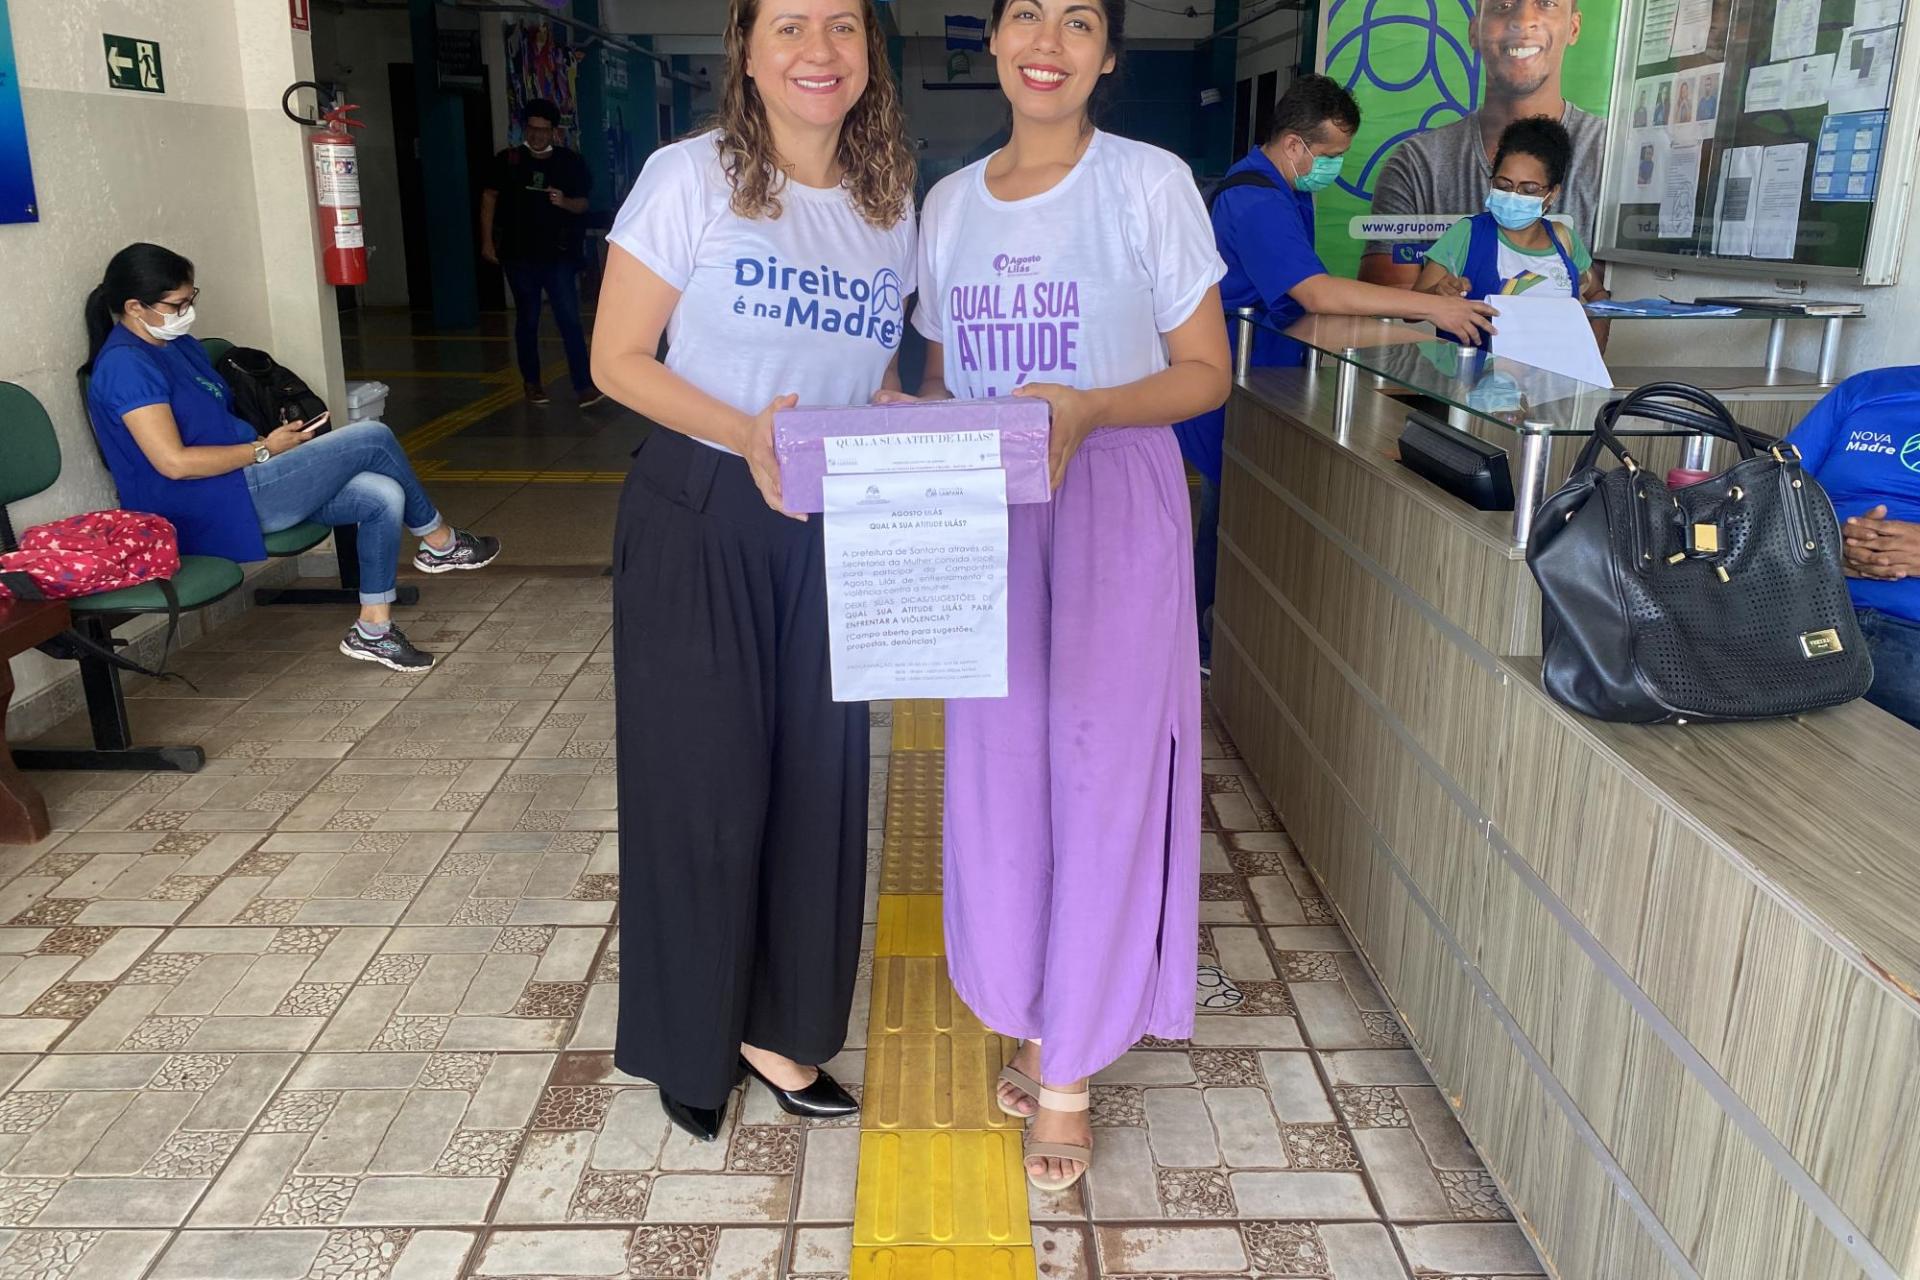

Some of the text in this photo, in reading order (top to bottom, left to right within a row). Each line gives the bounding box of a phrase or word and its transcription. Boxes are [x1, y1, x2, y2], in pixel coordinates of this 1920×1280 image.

[1010, 255, 1042, 266] Agosto
[1007, 264, 1031, 274] Lilás
[735, 256, 870, 302] Direito
[951, 281, 1079, 323] QUAL A SUA
[733, 296, 896, 343] é na Madre
[957, 322, 1079, 372] ATITUDE
[836, 438, 869, 449] QUAL
[870, 438, 877, 446] A
[879, 436, 901, 446] SUA
[906, 434, 953, 445] ATITUDE
[1850, 430, 1892, 444] NOVA
[1845, 441, 1896, 455] Madre
[891, 510, 923, 518] AGOSTO
[869, 522, 890, 531] QUAL
[899, 521, 913, 529] SUA
[915, 520, 944, 528] ATITUDE
[944, 517, 967, 528] LILÁS?
[851, 548, 893, 558] prefeitura
[895, 547, 907, 555] de
[909, 546, 945, 555] Santana
[888, 559, 900, 567] da
[903, 557, 932, 566] Mulher
[935, 555, 970, 564] convida
[902, 576, 914, 584] de
[883, 586, 912, 595] contra
[913, 585, 920, 593] a
[845, 602, 994, 619] QUAL SUA ATITUDE LILÁS PARA
[846, 617, 891, 629] ENFRENTAR
[893, 617, 899, 625] A
[846, 630, 881, 643] (Campo
[882, 628, 910, 637] aberto
[911, 628, 931, 636] para
[890, 636, 937, 647] denúncias)
